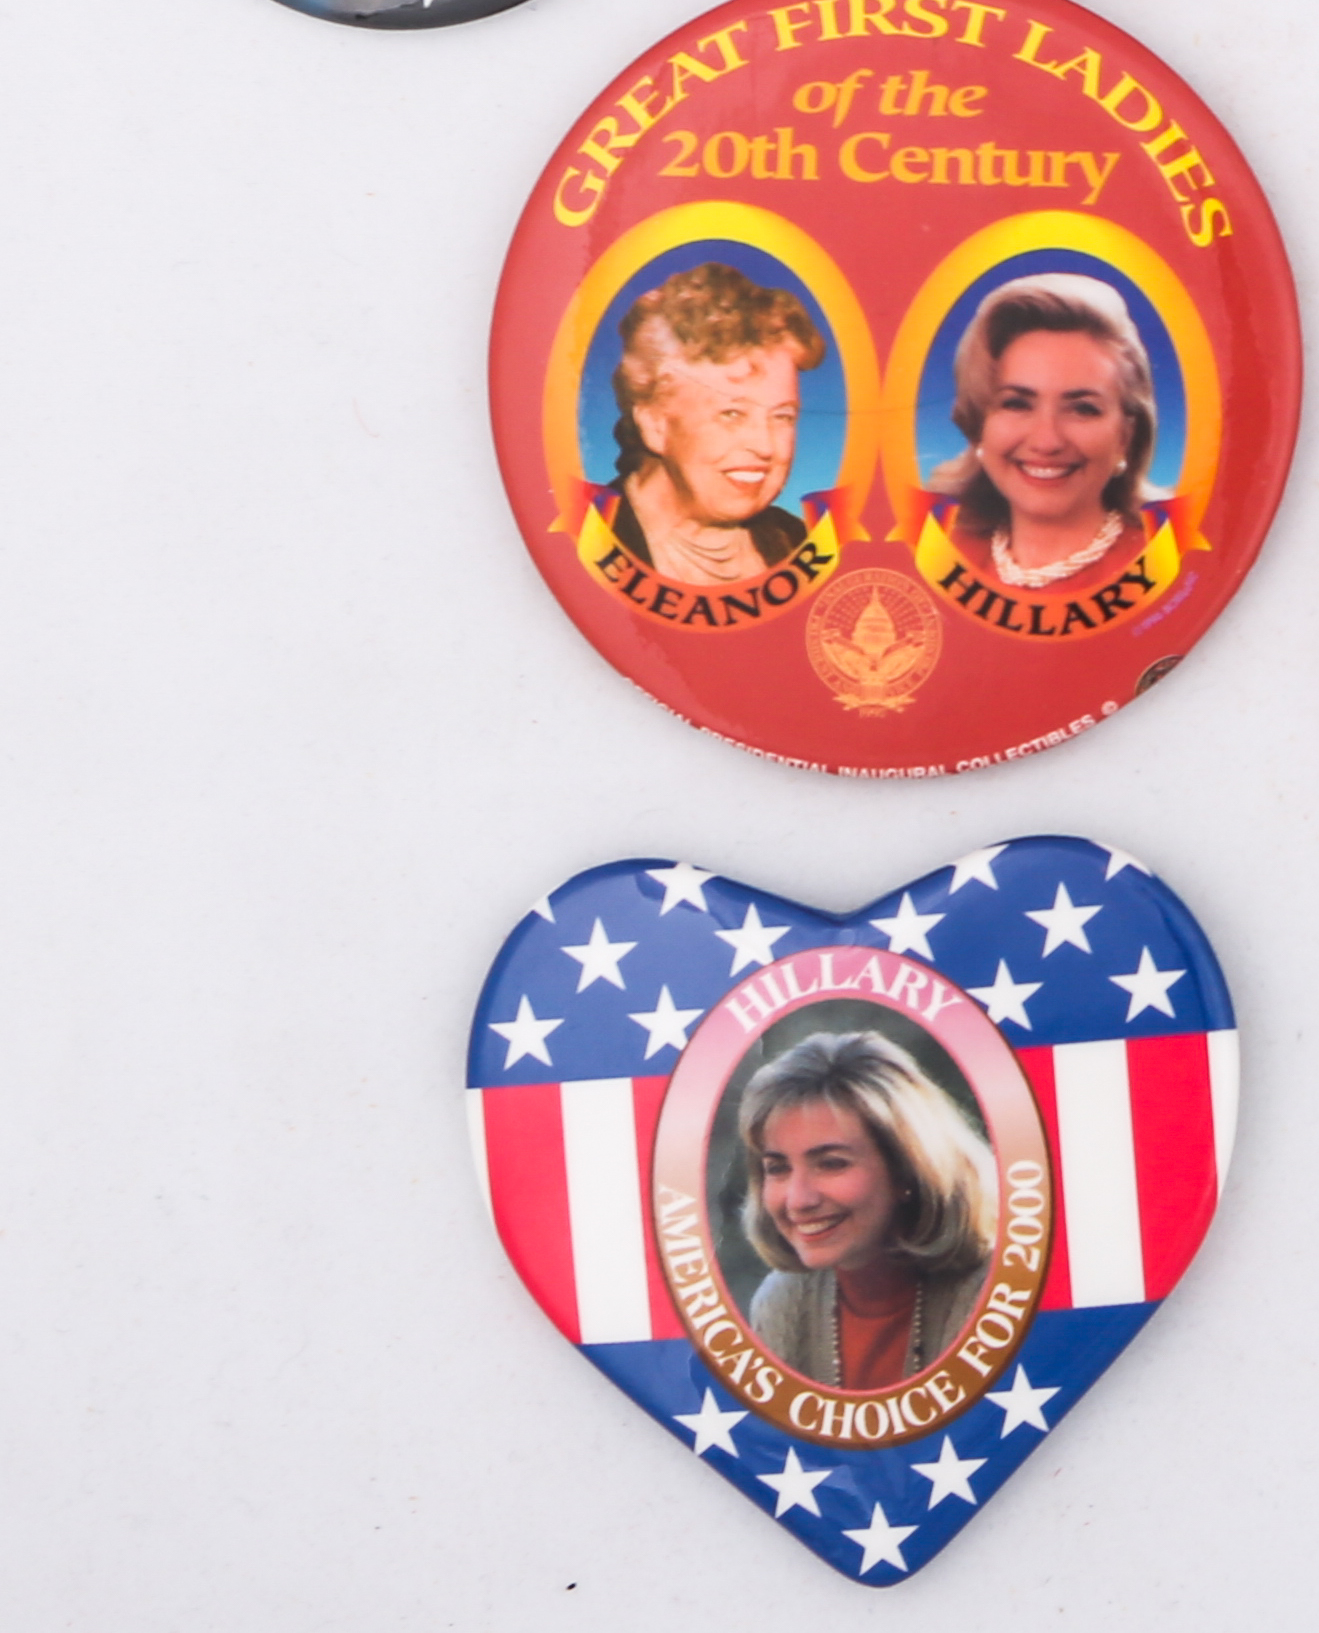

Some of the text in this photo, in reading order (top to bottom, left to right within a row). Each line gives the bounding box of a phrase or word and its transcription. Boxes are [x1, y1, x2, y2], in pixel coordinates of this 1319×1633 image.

[552, 21, 748, 227] GREAT
[1012, 20, 1232, 249] LADIES
[793, 70, 988, 126] of the
[659, 130, 1121, 205] 20th Century
[594, 537, 837, 628] ELEANOR
[937, 555, 1158, 638] HILLARY
[955, 714, 1096, 774] COLLECTIBLES
[723, 951, 964, 1034] HILLARY
[659, 1158, 1046, 1440] AMERICA'S CHOICE FOR 2000
